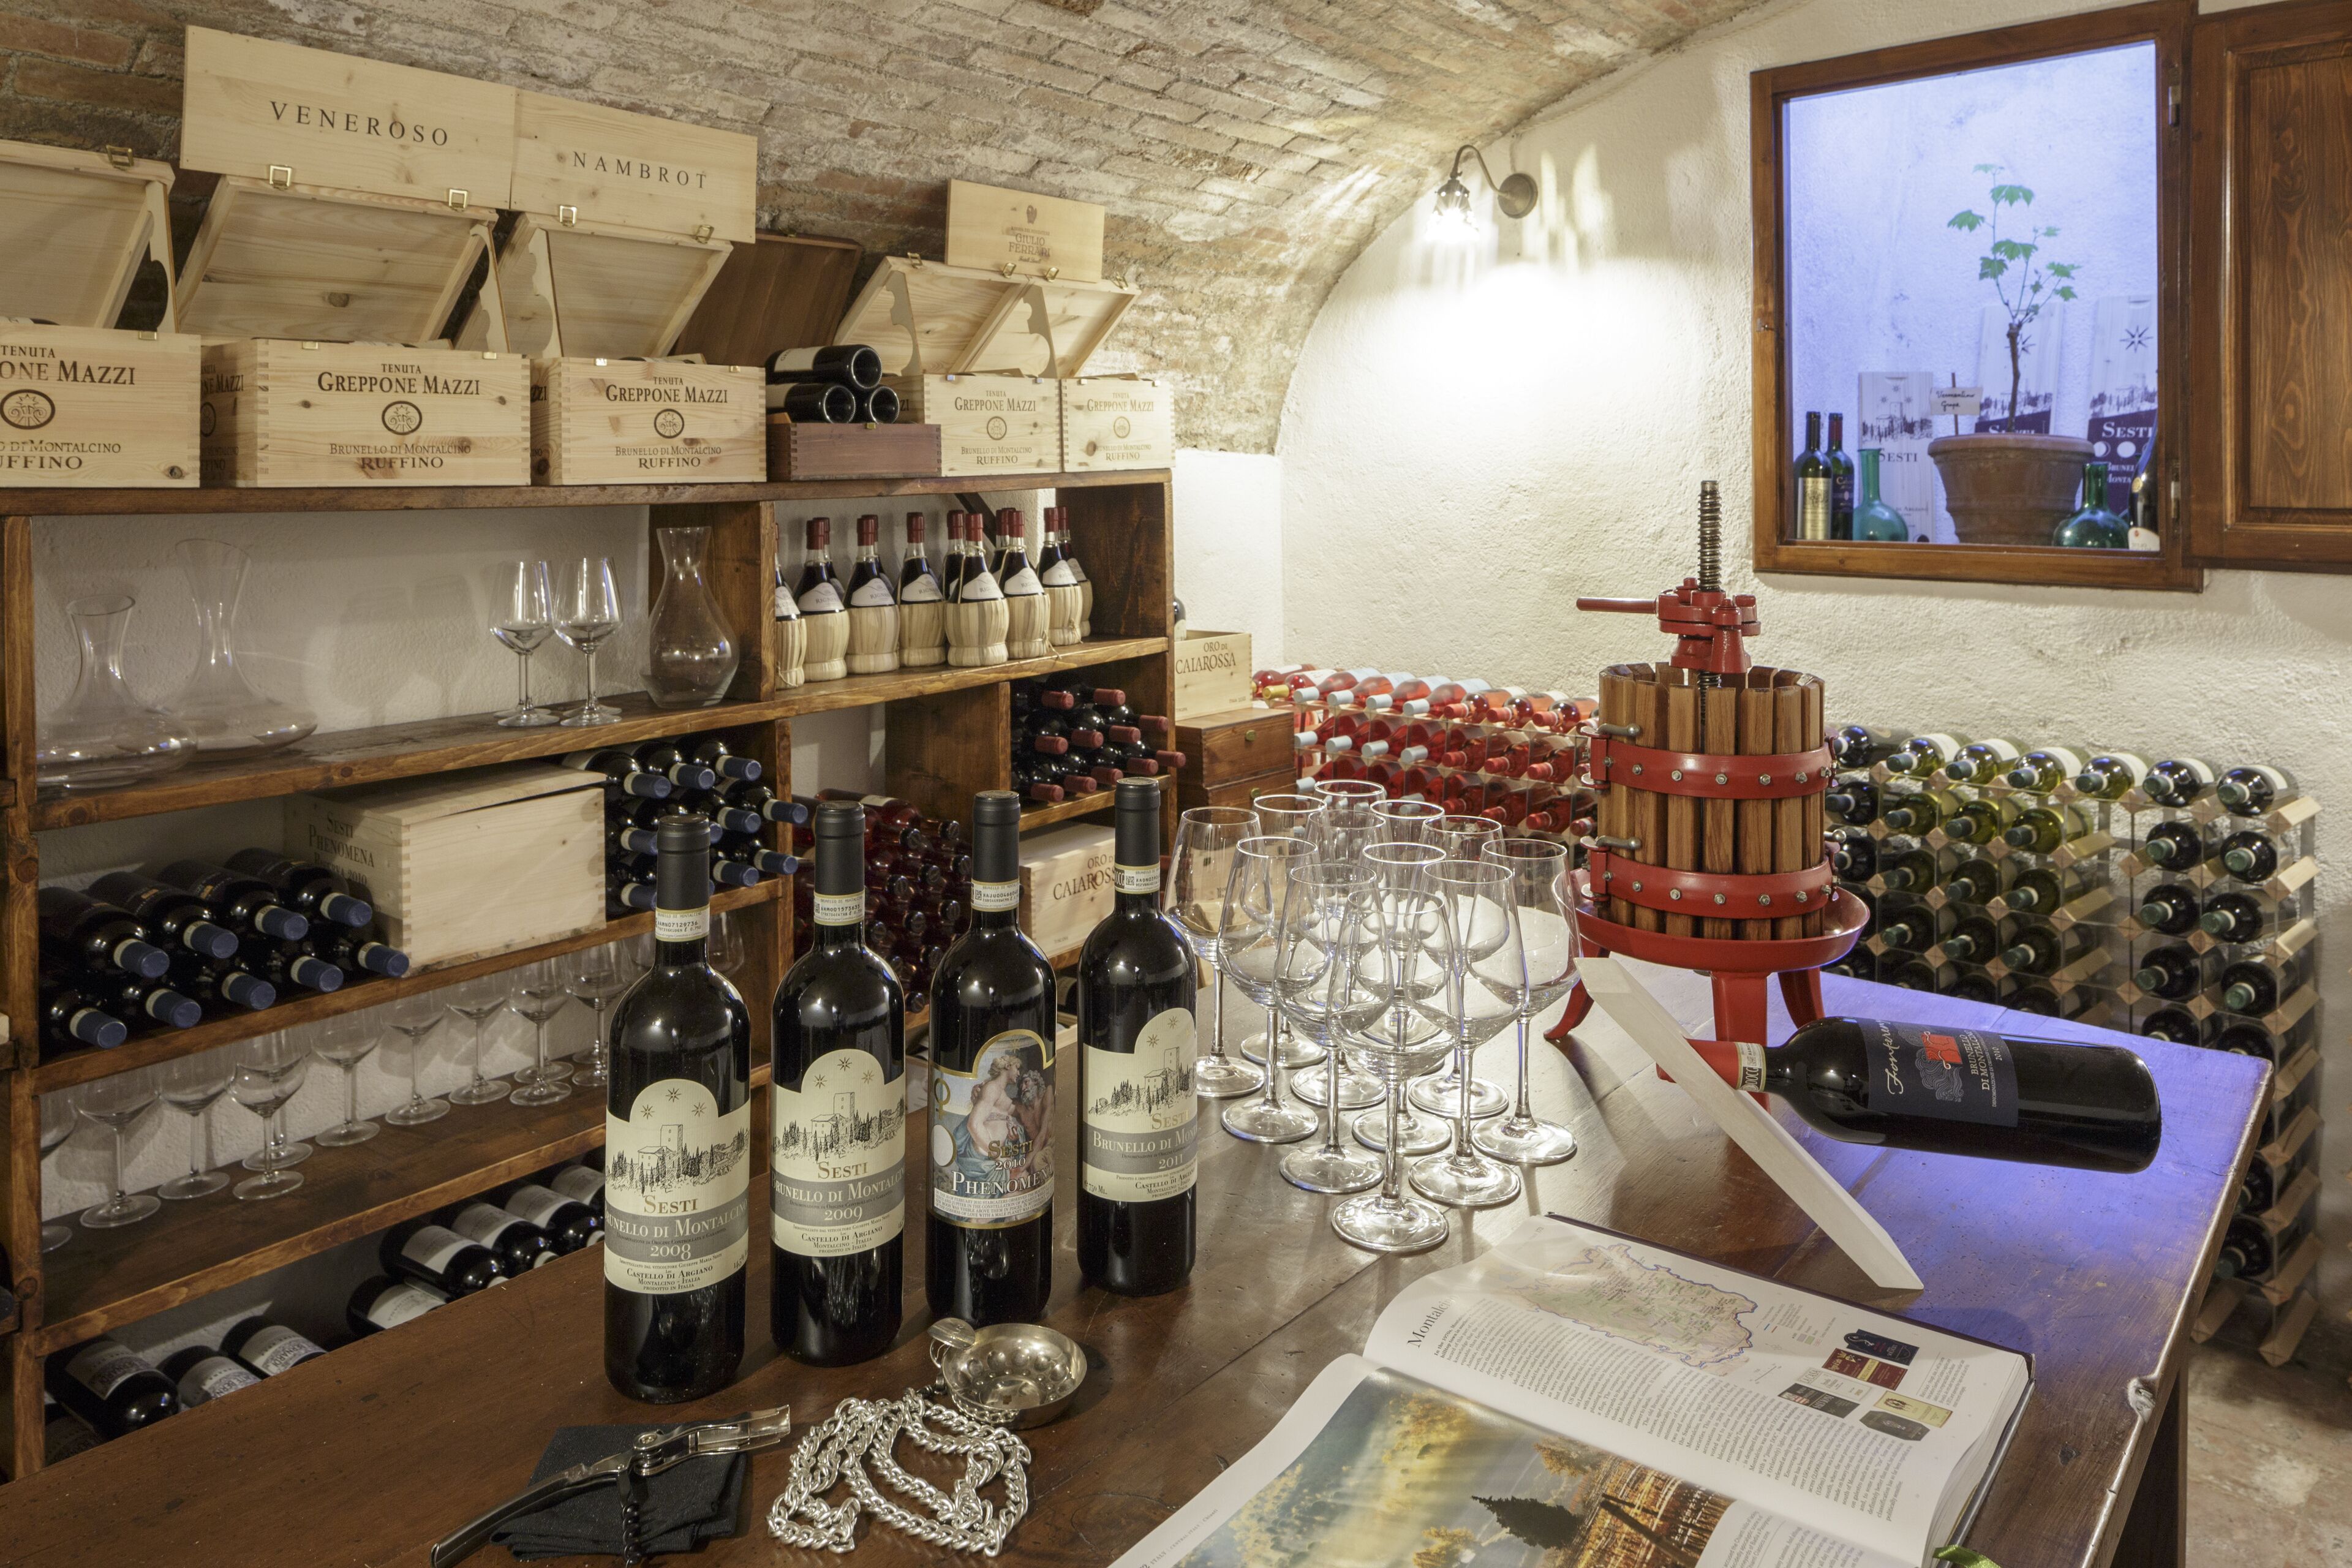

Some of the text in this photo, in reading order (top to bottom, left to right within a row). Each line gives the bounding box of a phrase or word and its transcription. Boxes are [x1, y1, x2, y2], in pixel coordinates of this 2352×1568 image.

[270, 101, 450, 146] VENEROSO
[573, 151, 707, 189] NAMBROT
[1015, 233, 1045, 246] GIULIO
[1009, 242, 1050, 257] FERRARI
[1, 345, 55, 358] TENUTA
[57, 360, 135, 385] MAZZI
[381, 364, 421, 374] TENUTA
[318, 372, 480, 395] GREPPONE MAZZI
[606, 385, 728, 404] GREPPONE MAZZI
[954, 397, 1036, 412] GREPPONE MAZZI
[1087, 399, 1154, 412] GREPPONE MAZZI
[28, 440, 121, 453] MONTALCINO
[330, 443, 471, 455] BRUNELLO DI MONTALCINO
[616, 447, 658, 456] BRUNELLO
[671, 446, 721, 455] MONTALCINO
[1880, 448, 1918, 462] SESTI
[361, 457, 443, 470] RUFFINO
[639, 458, 700, 469] RUFFINO
[976, 455, 1018, 465] RUFFINO
[1204, 641, 1219, 652] ORO
[1175, 652, 1236, 674] CAIAROSSA
[327, 812, 353, 838] SESTI
[309, 824, 374, 867] PHENOMENA
[1088, 854, 1107, 869] ORO
[1959, 1035, 1978, 1075] BRUNELLO
[1992, 1047, 2002, 1061] 2010
[1982, 1080, 1989, 1090] DI
[1152, 1110, 1189, 1129] SESTI
[988, 1140, 1033, 1158] SESTI
[1093, 1131, 1155, 1152] BRUNELLO
[1160, 1139, 1170, 1148] DI
[818, 1161, 869, 1179] SESTI
[994, 1157, 1026, 1171] 2010
[1159, 1154, 1183, 1169] 2011
[772, 1174, 823, 1202] BRUNELLO
[828, 1191, 842, 1202] DI
[1088, 1182, 1097, 1193] 750
[1135, 1180, 1169, 1190] CASTELLO
[1147, 1185, 1177, 1195] MONTALCINO
[644, 1195, 698, 1215] SESTI
[824, 1205, 862, 1222] 2009
[654, 1226, 668, 1238] DI
[674, 1198, 748, 1237] MONTALCINO
[802, 1233, 838, 1243] CASTELLO
[852, 1226, 883, 1240] ARGIANO
[856, 1237, 872, 1246] ITALIA
[650, 1243, 691, 1261] 2008
[627, 1267, 663, 1280] CASTELLO
[678, 1264, 713, 1278] ARGIANO
[682, 1275, 701, 1284] ITALIA
[1407, 1295, 1460, 1348] Montalcino
[1441, 1343, 1450, 1358] hilltop
[1656, 1411, 1672, 1437] considerably
[1664, 1418, 1676, 1439] minimum
[1686, 1422, 1702, 1448] Montalcino,
[1694, 1430, 1706, 1451] varieties.
[1702, 1427, 1717, 1453] accusations
[1709, 1443, 1719, 1457] voted
[1717, 1439, 1730, 1460] blending
[1749, 1445, 1765, 1471] Montalcino
[1766, 1448, 1782, 1472] (relatively)
[1784, 1452, 1800, 1478] Encouraged
[1824, 1469, 1838, 1499] south, where
[1853, 1482, 1864, 1501] galestro
[1833, 1488, 1841, 1501] made
[1841, 1490, 1850, 1504] south
[1867, 1491, 1880, 1514] definitely
[1875, 1487, 1892, 1518] classification
[1884, 1497, 1898, 1521] politically
